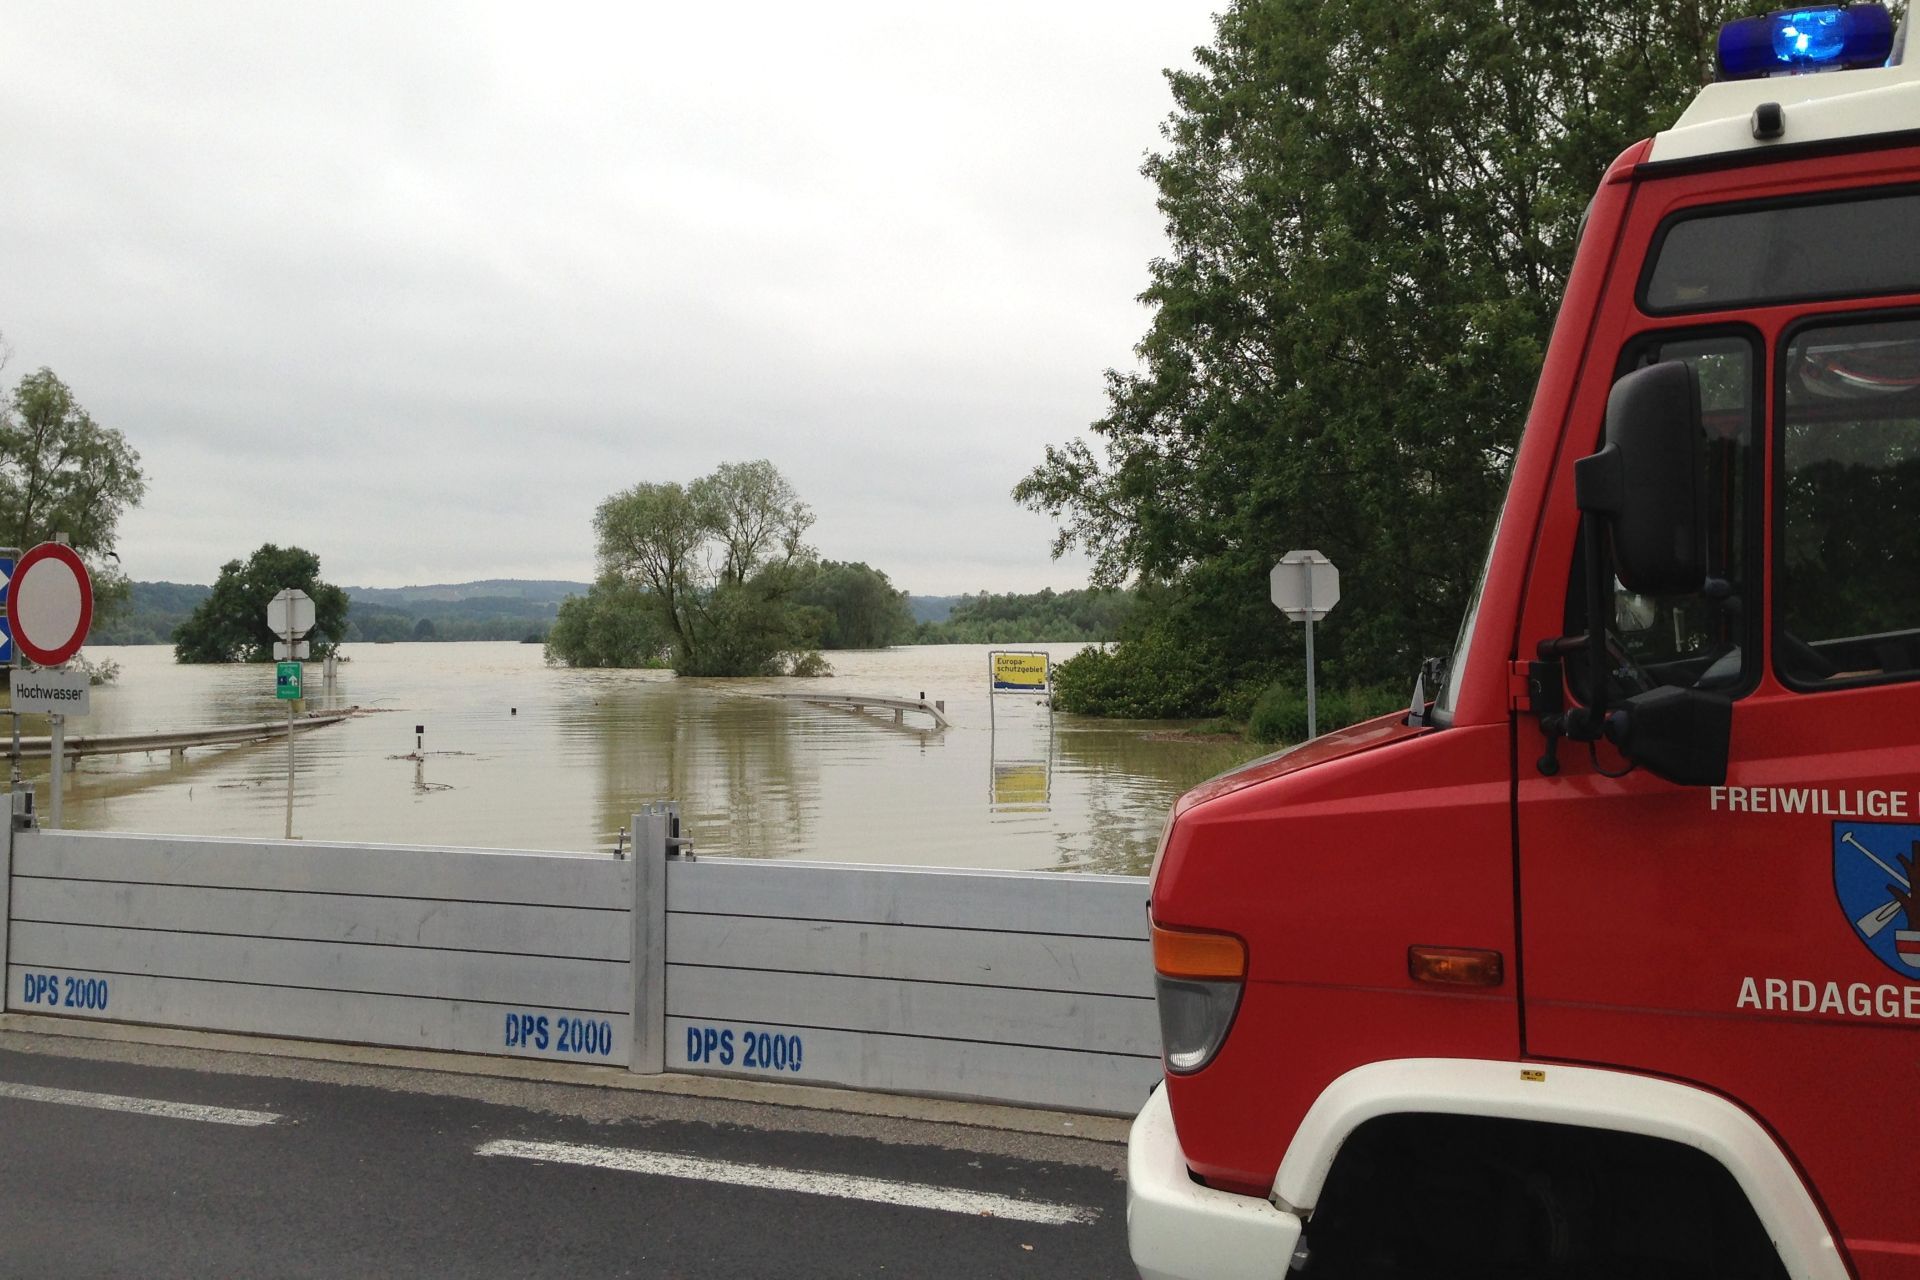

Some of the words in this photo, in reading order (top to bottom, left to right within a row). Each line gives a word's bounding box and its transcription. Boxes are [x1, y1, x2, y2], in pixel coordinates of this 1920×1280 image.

[997, 657, 1025, 666] Europa-
[997, 665, 1043, 674] schutzgebiet
[16, 683, 83, 701] Hochwasser
[1710, 786, 1908, 817] FREIWILLIGE
[24, 973, 59, 1006] DPS
[64, 976, 108, 1010] 2000
[1736, 976, 1920, 1019] ARDAGGE
[505, 1013, 549, 1050] DPS
[557, 1017, 612, 1056] 2000
[687, 1027, 734, 1066] DPS
[743, 1031, 802, 1072] 2000
